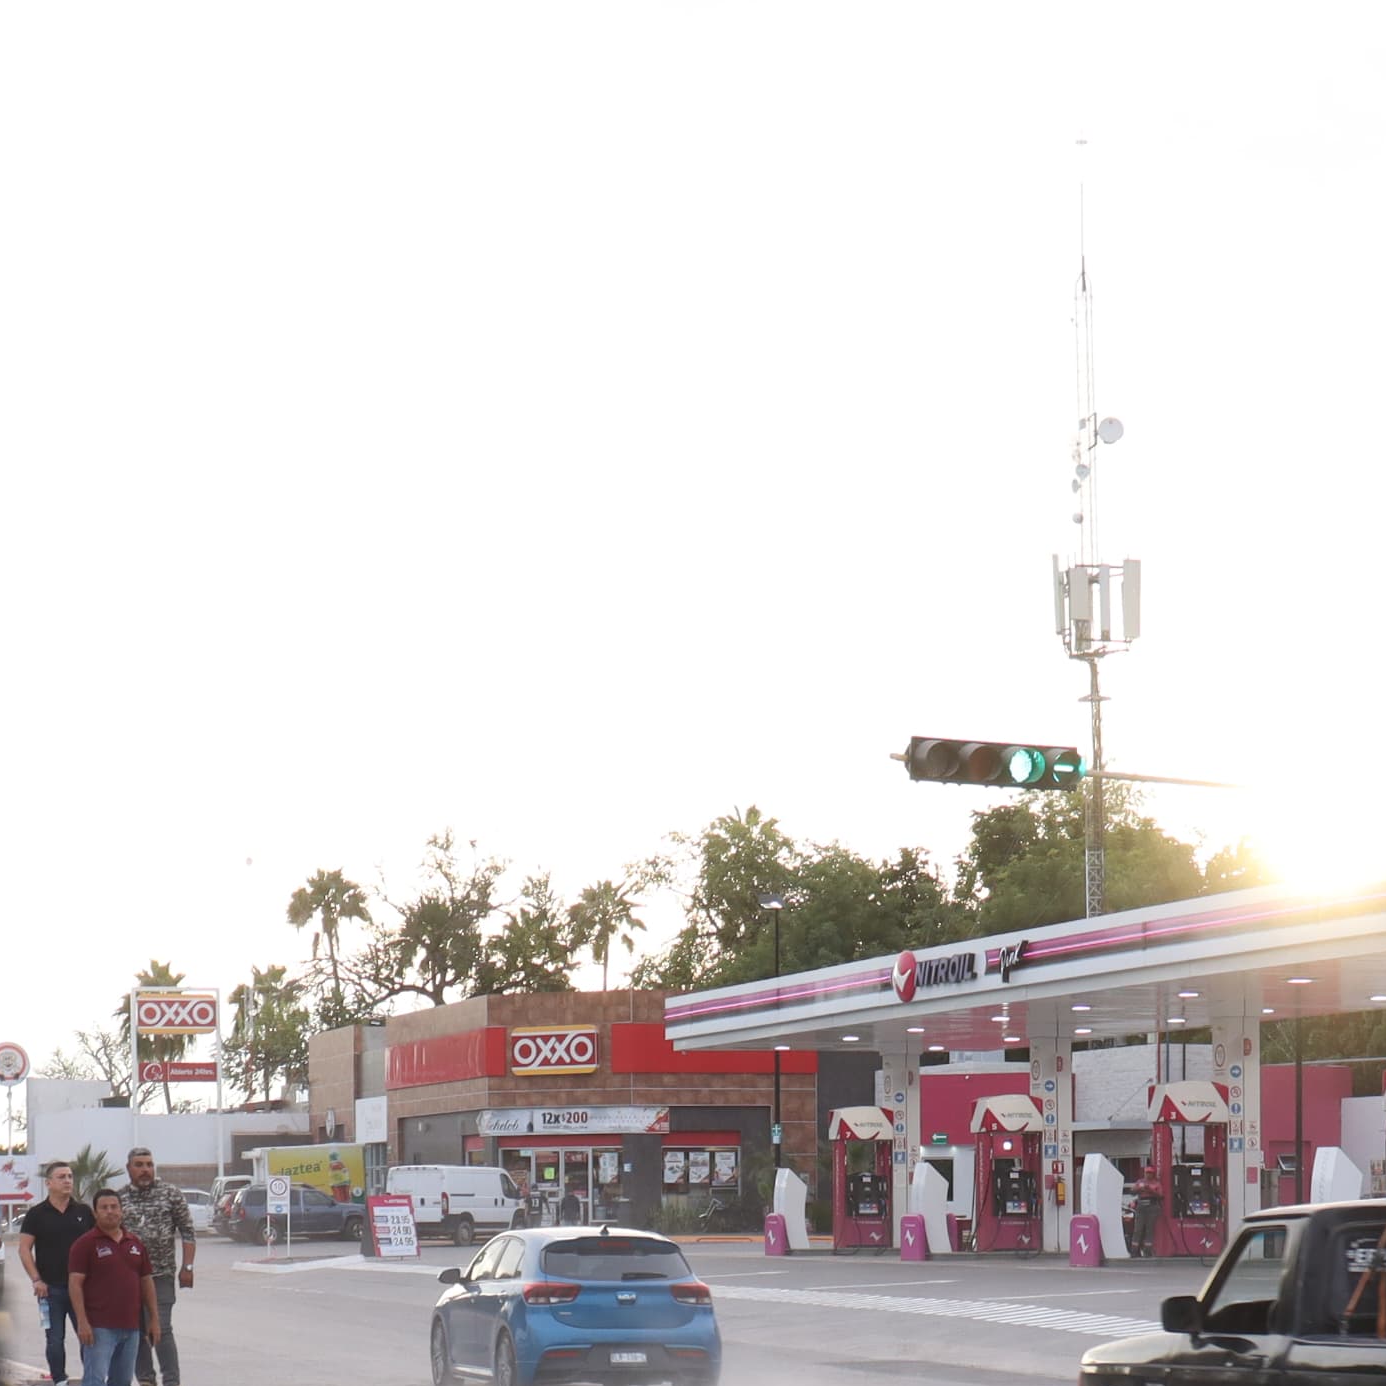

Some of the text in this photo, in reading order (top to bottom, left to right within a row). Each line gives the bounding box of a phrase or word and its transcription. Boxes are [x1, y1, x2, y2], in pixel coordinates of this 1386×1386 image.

[915, 953, 976, 986] NITROIL
[140, 1001, 214, 1026] OXXO
[514, 1033, 594, 1066] OXXO
[845, 1131, 852, 1139] 7
[991, 1122, 998, 1131] 5
[273, 1182, 283, 1191] 10
